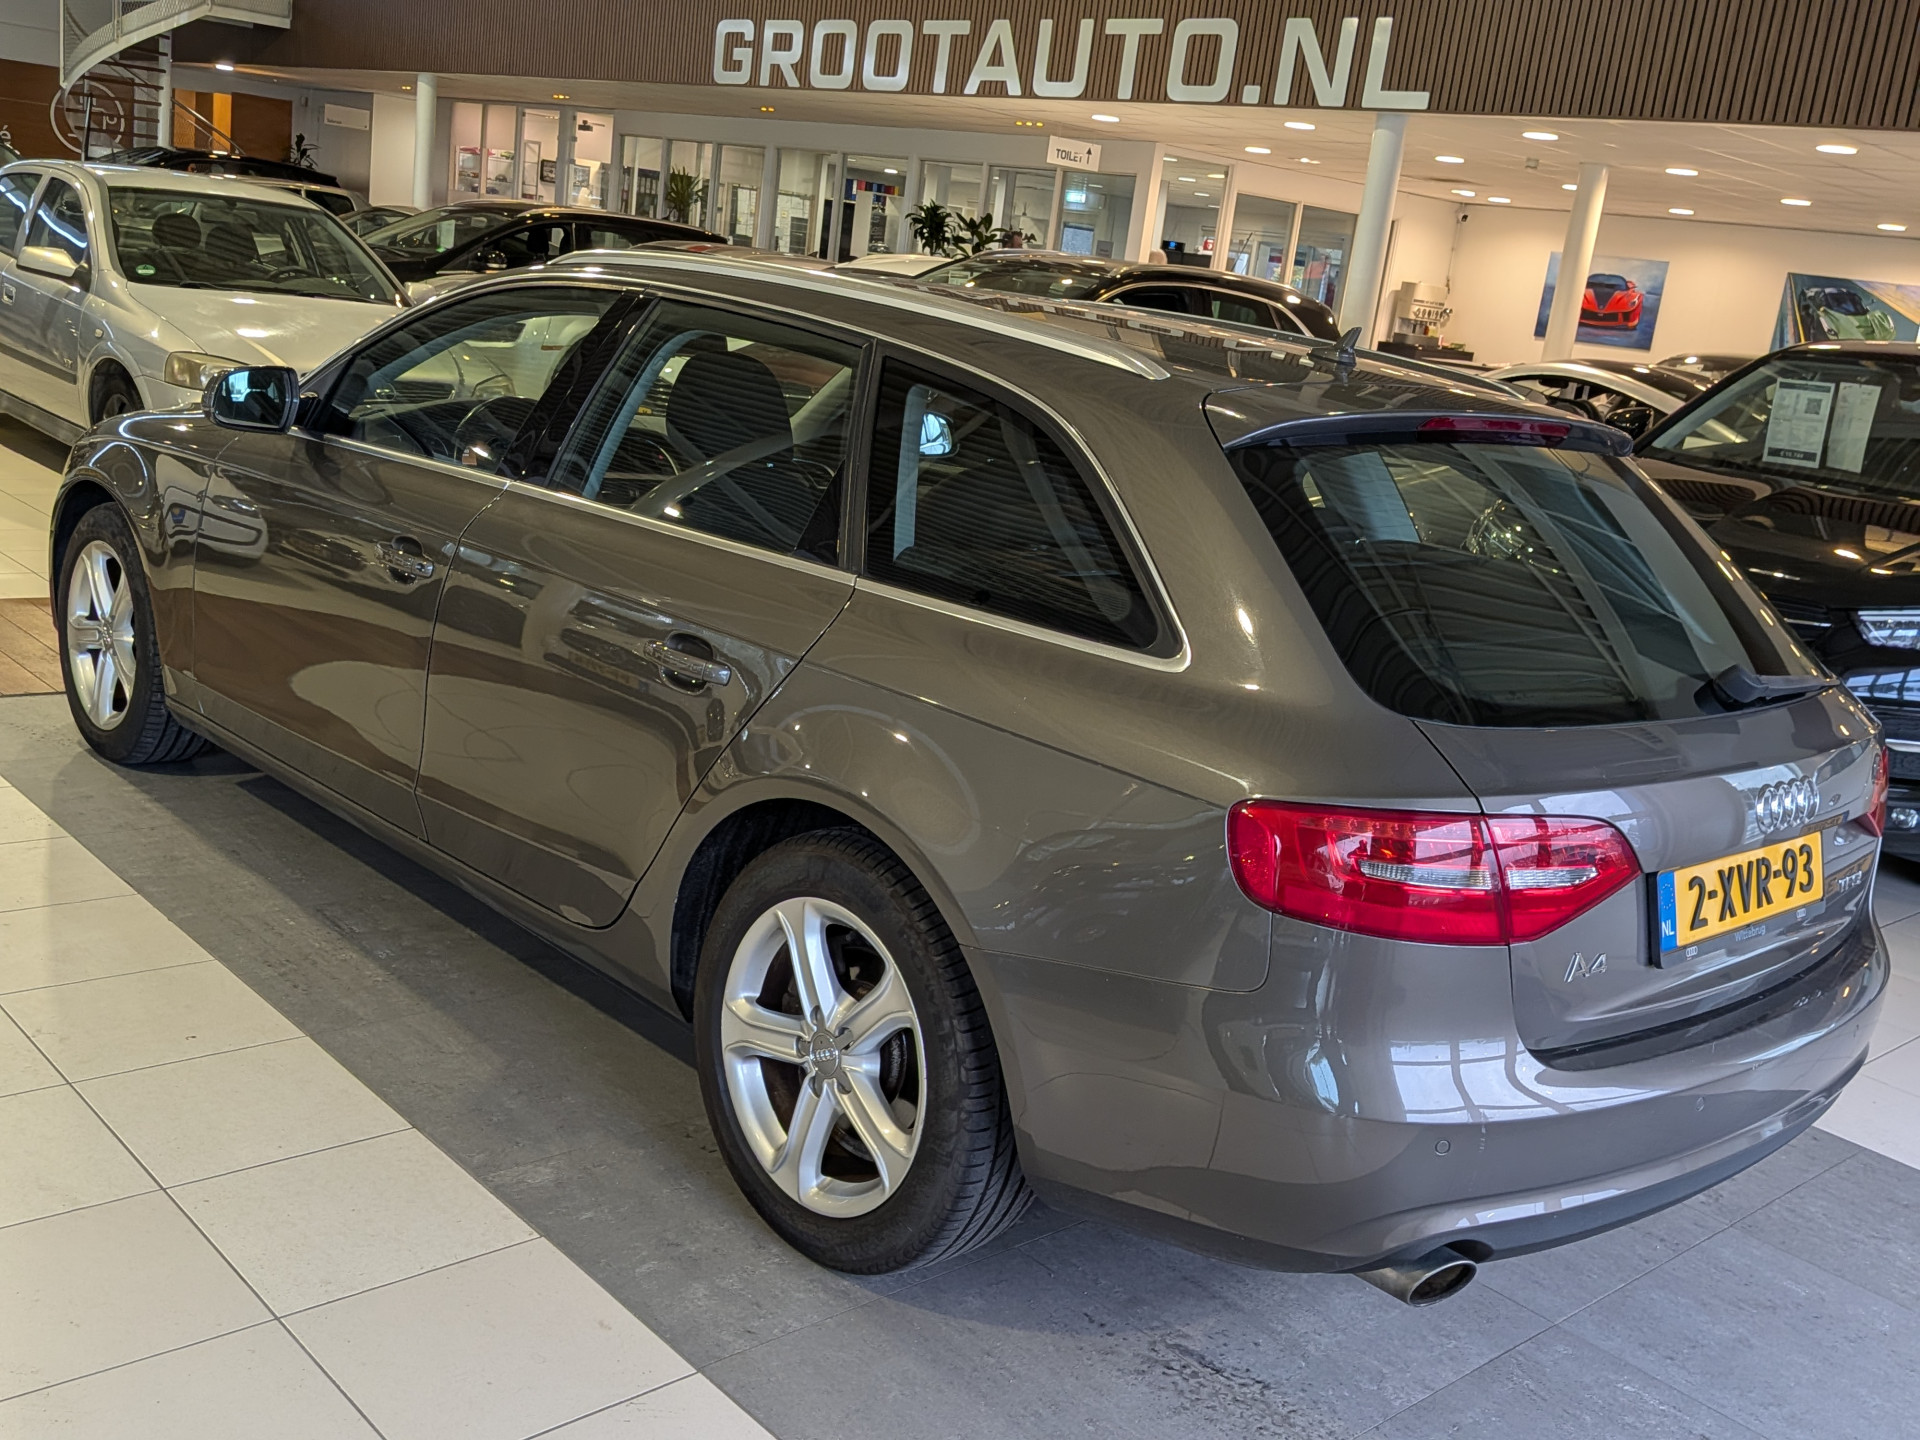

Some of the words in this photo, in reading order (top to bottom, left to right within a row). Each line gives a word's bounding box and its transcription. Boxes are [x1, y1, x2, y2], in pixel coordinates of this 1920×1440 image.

[712, 16, 1430, 109] GROOTAUTO.NL
[1056, 148, 1083, 163] TOILET
[1688, 843, 1814, 931] 2-XVR-93
[1661, 920, 1675, 938] NL
[1563, 952, 1607, 983] A4
